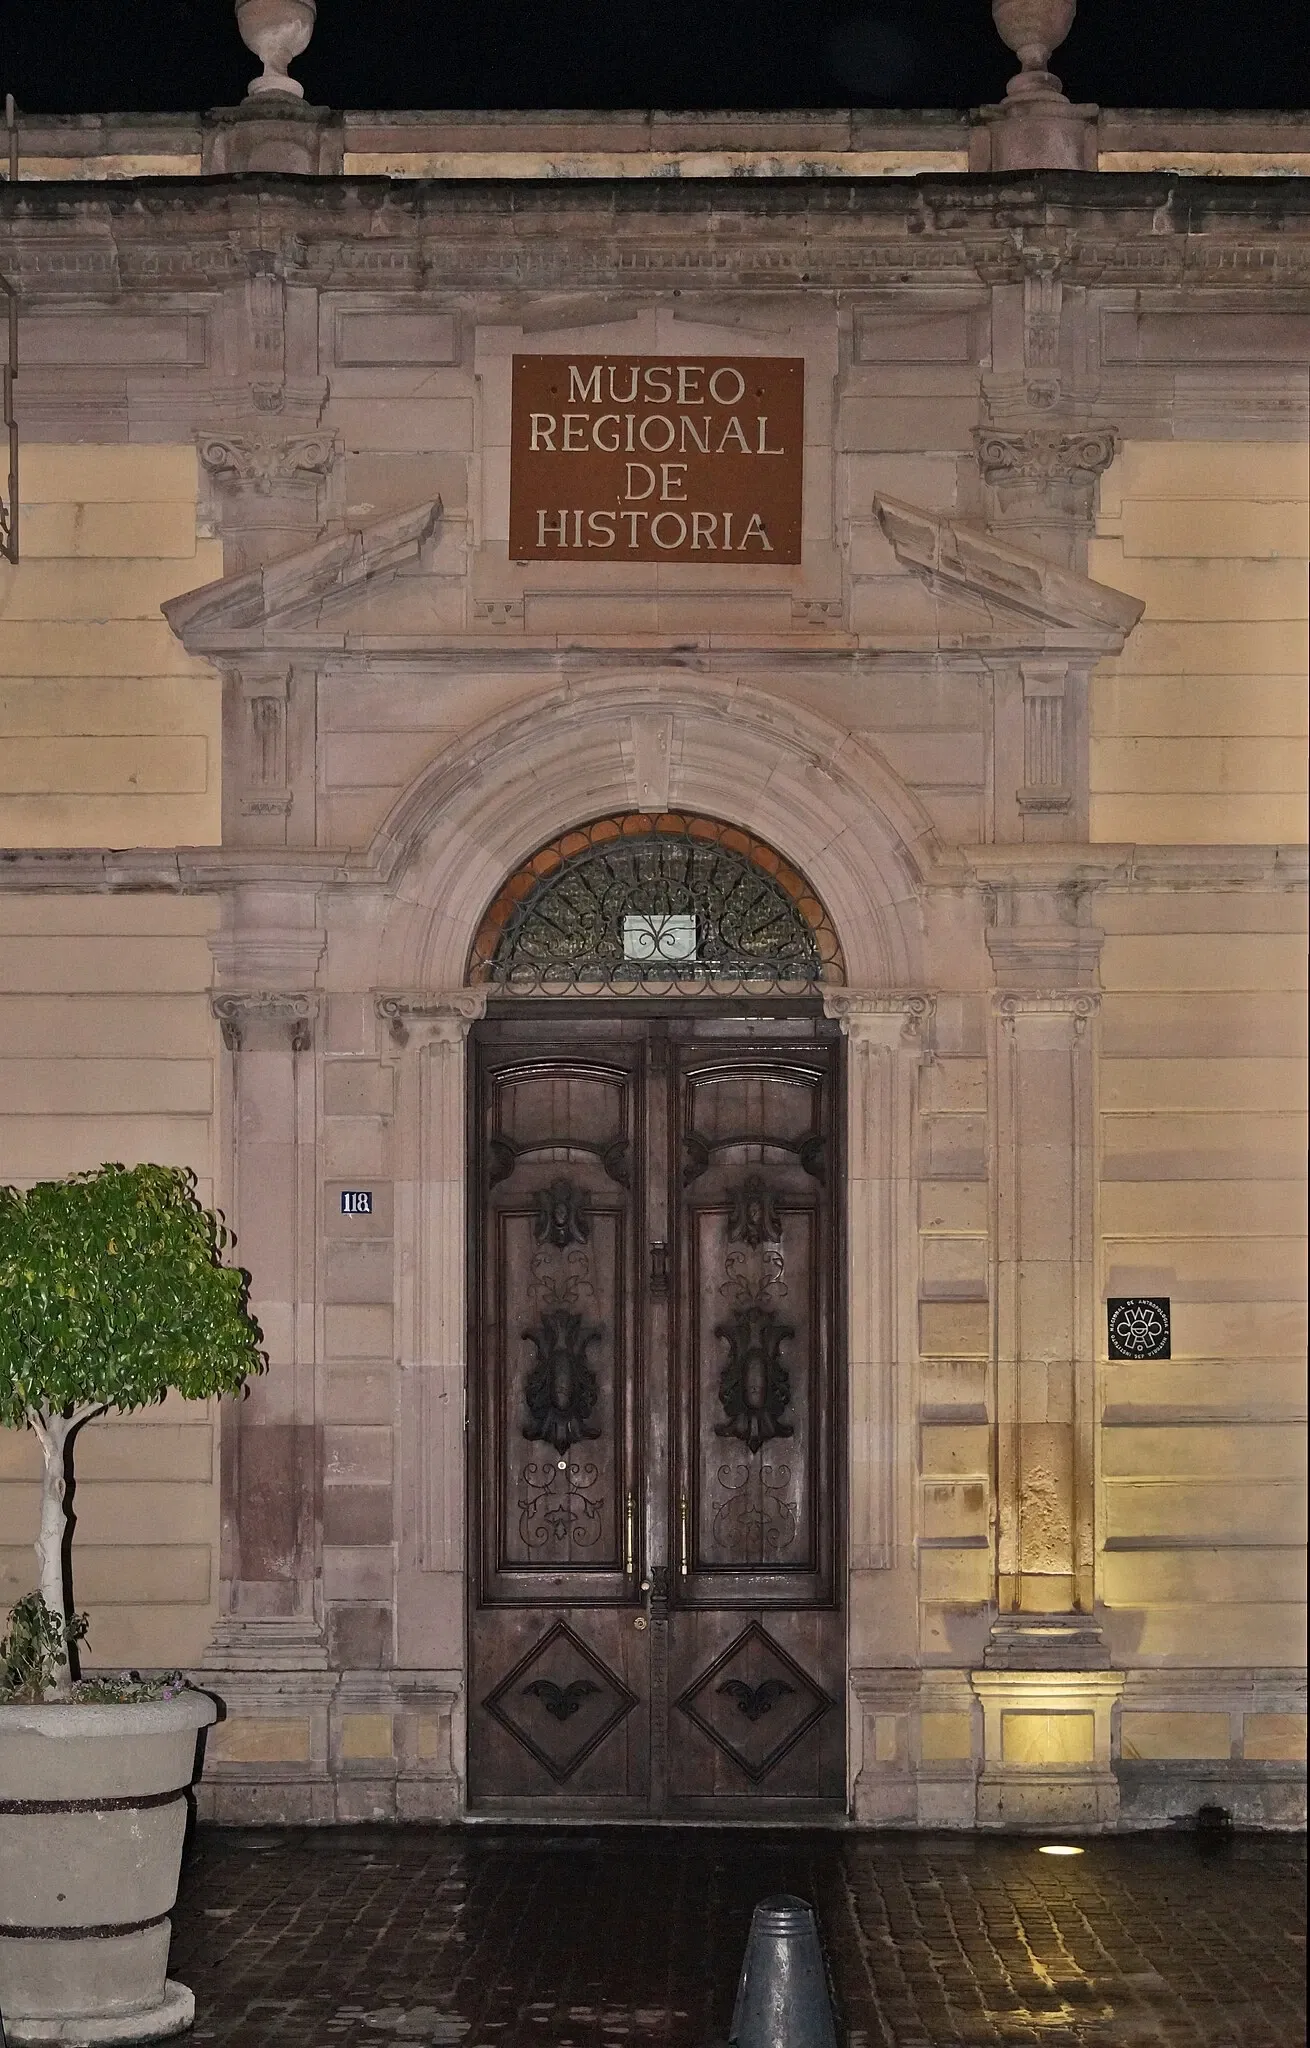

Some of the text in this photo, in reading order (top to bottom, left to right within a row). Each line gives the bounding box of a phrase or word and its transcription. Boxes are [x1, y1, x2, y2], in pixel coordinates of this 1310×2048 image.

[568, 365, 746, 405] MUSEO
[529, 413, 785, 455] REGIONAL
[624, 462, 688, 501] DE
[535, 510, 774, 551] HISTORIA
[343, 1193, 370, 1213] 118
[1109, 1305, 1125, 1332] NACIONAL
